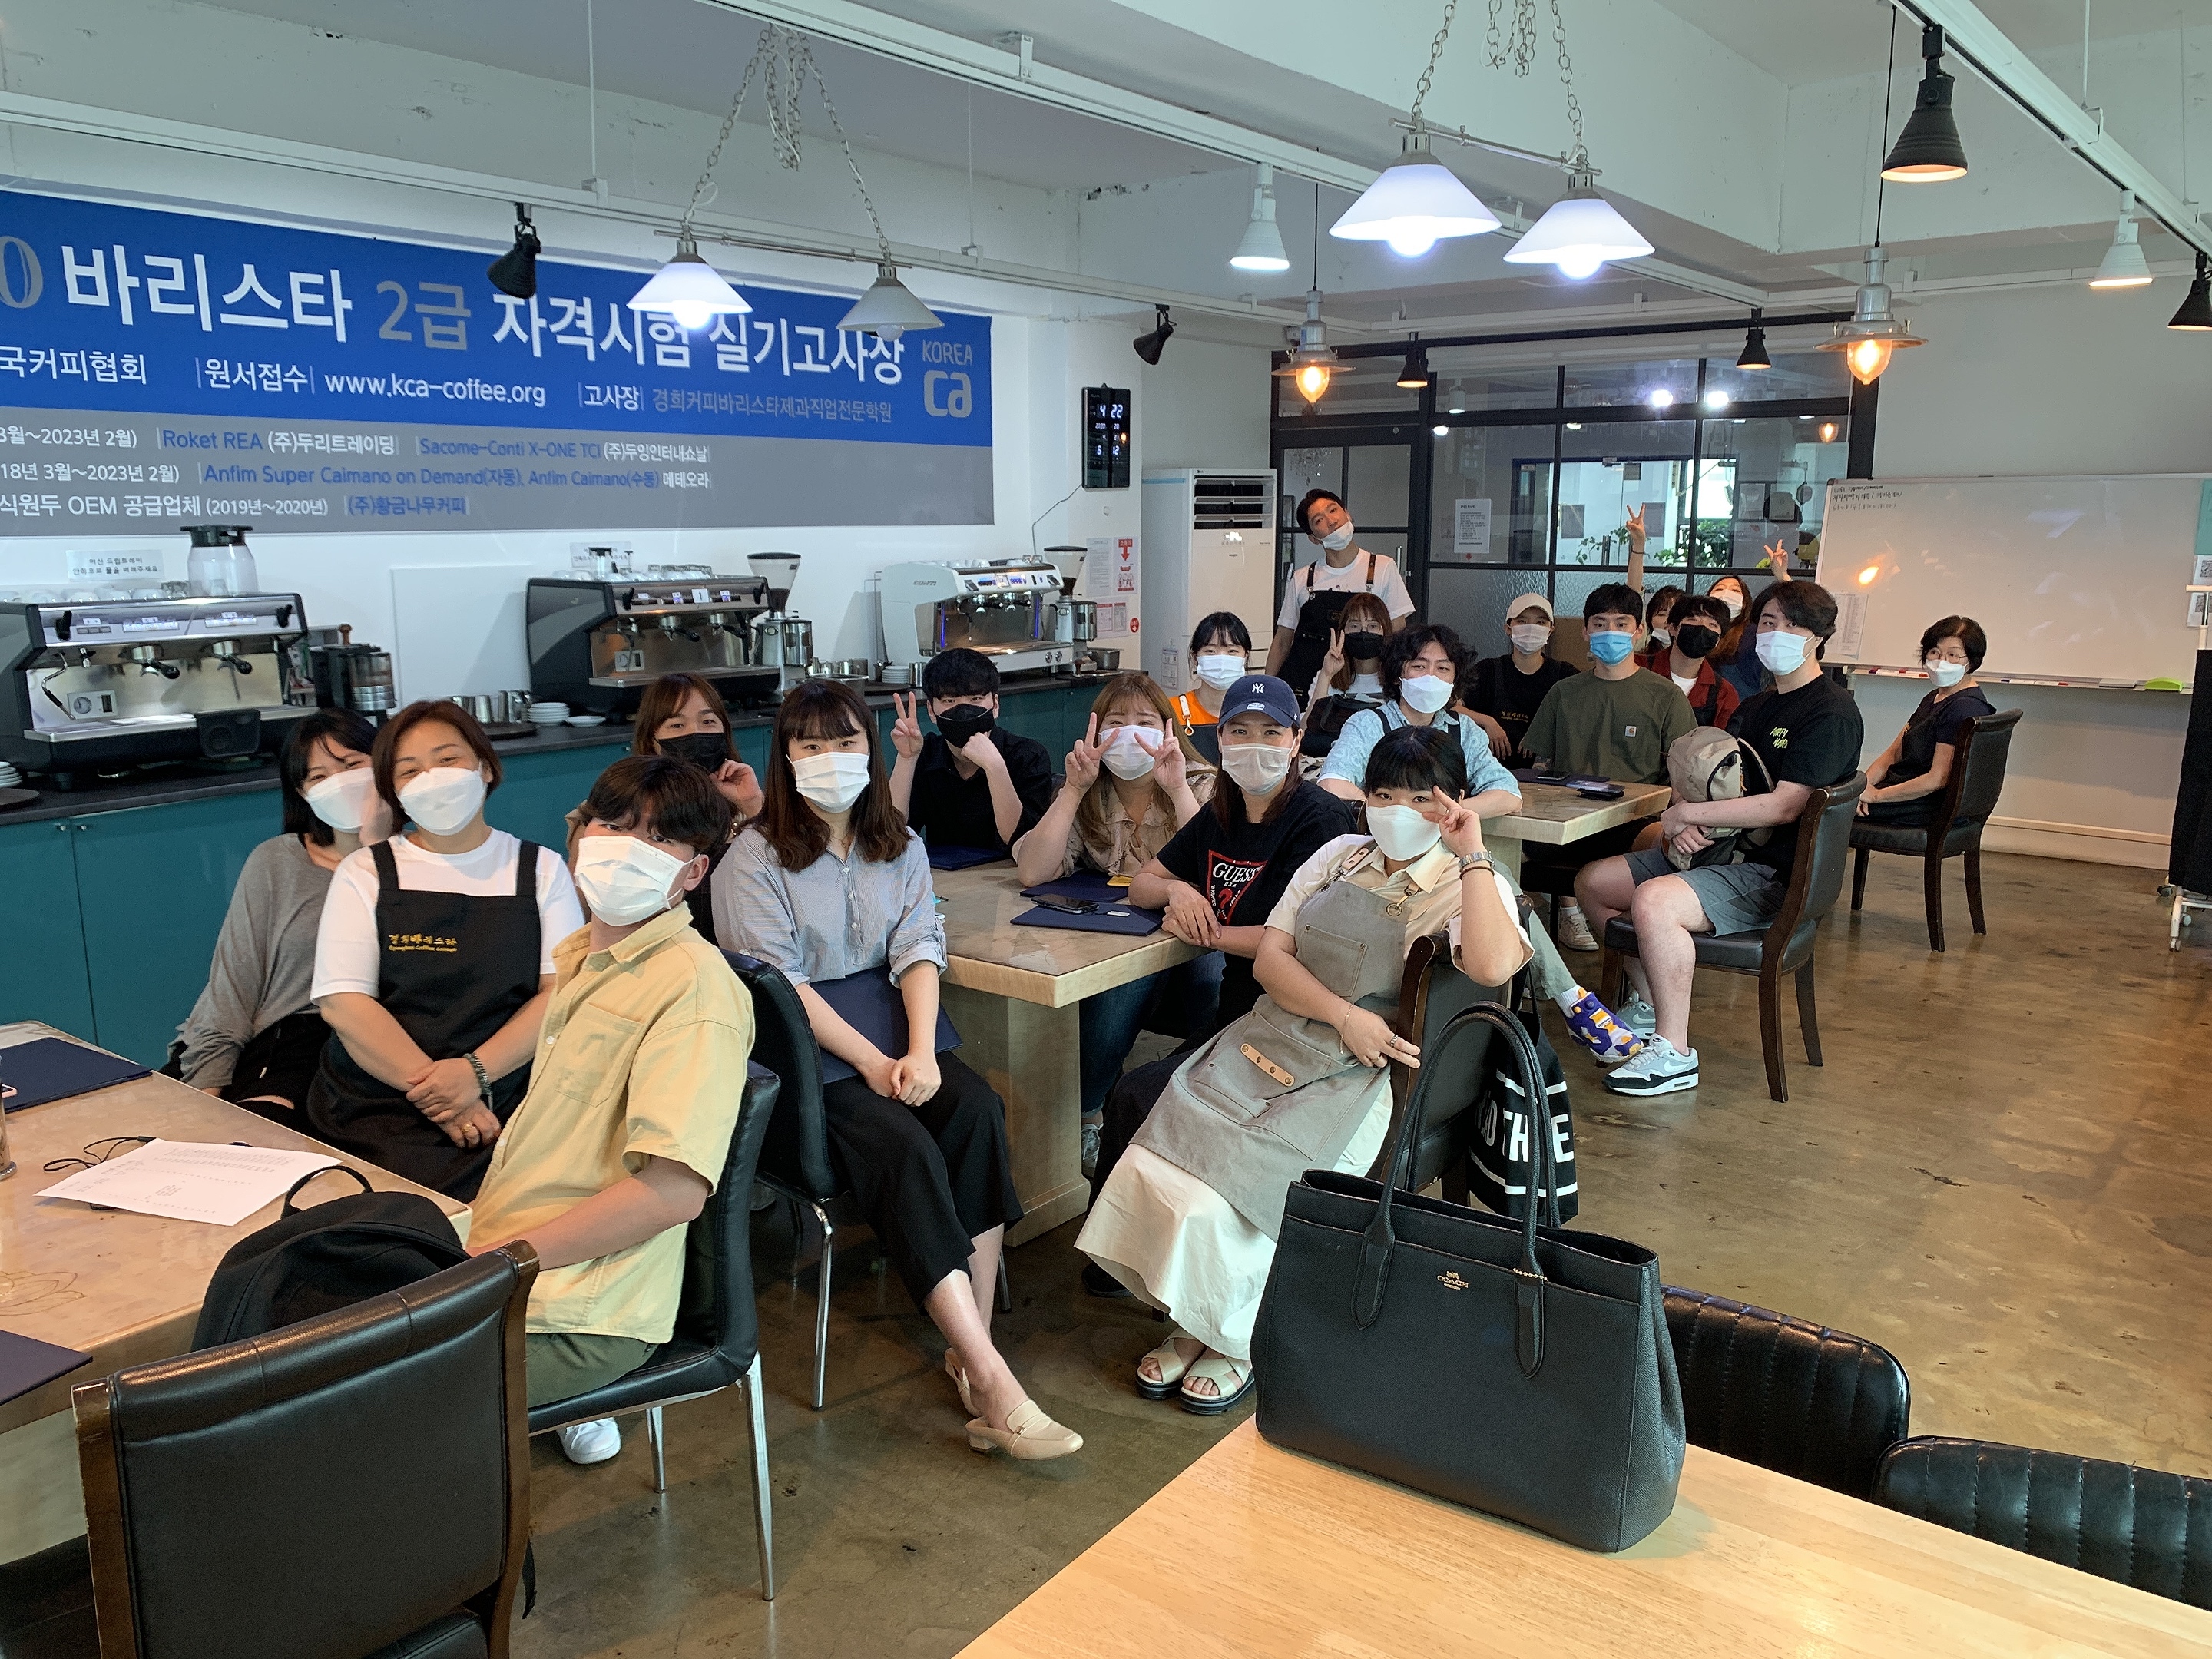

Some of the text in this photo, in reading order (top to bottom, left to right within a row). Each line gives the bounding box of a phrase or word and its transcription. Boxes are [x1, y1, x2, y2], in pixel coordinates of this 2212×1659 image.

[61, 244, 353, 343] 바리스타
[377, 280, 472, 350] 2급
[492, 292, 691, 369] 자격시험
[708, 314, 905, 385] 실기고사장
[922, 339, 973, 366] KOREA
[0, 346, 892, 423] 국커피협회 원서접수 www.kca-coffee.org 고사장 경희커피바리스타제과직업전문학원
[104, 430, 137, 449] 2월)
[163, 429, 218, 449] Roket
[224, 432, 263, 449] REA
[268, 430, 396, 455] (주)두리트레이딩
[420, 438, 525, 456] Sacome-Conti
[528, 441, 576, 458] X-ONE
[43, 462, 144, 482] 3월~2023년
[148, 465, 180, 483] 2월)
[204, 465, 257, 482] Anfim
[263, 466, 315, 485] Super
[320, 466, 391, 485] Caimano
[396, 470, 416, 484] on
[528, 472, 567, 486] Anfim
[571, 470, 659, 488] Caimano(수동)
[68, 495, 118, 515] OEM
[123, 495, 201, 517] 공급업체
[206, 498, 328, 517] (2019년~2020년)
[1251, 682, 1265, 694] NY
[1213, 863, 1263, 882] GUESS
[1436, 1275, 1469, 1288] COACH
